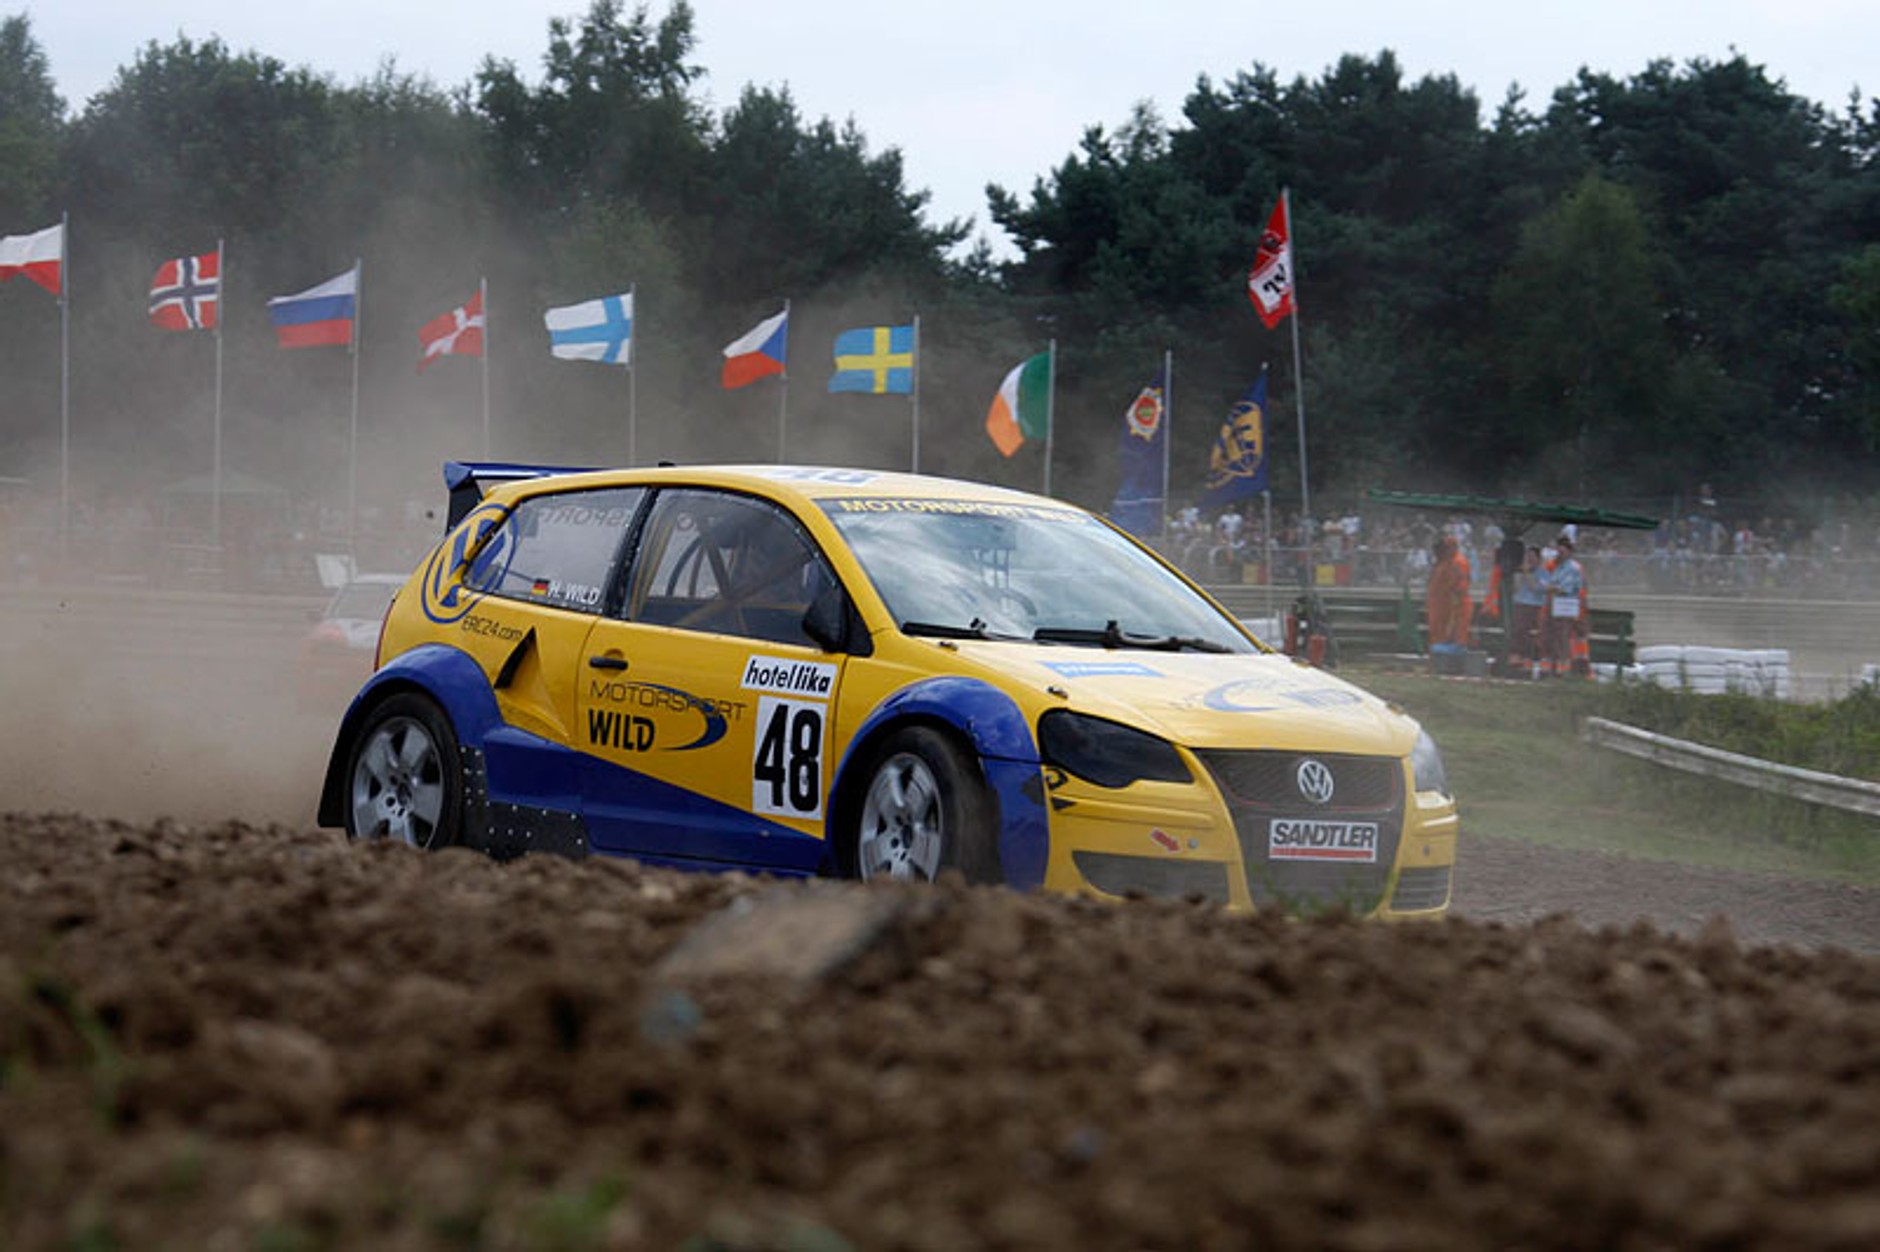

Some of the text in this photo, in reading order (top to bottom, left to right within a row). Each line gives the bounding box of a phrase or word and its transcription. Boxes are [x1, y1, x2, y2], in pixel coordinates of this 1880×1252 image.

[565, 584, 600, 604] WILD
[462, 615, 523, 639] ERC24.com
[590, 681, 747, 721] MOTORSPORT
[589, 709, 655, 752] WILD
[754, 703, 822, 812] 48
[1273, 822, 1376, 848] SANDTLER
